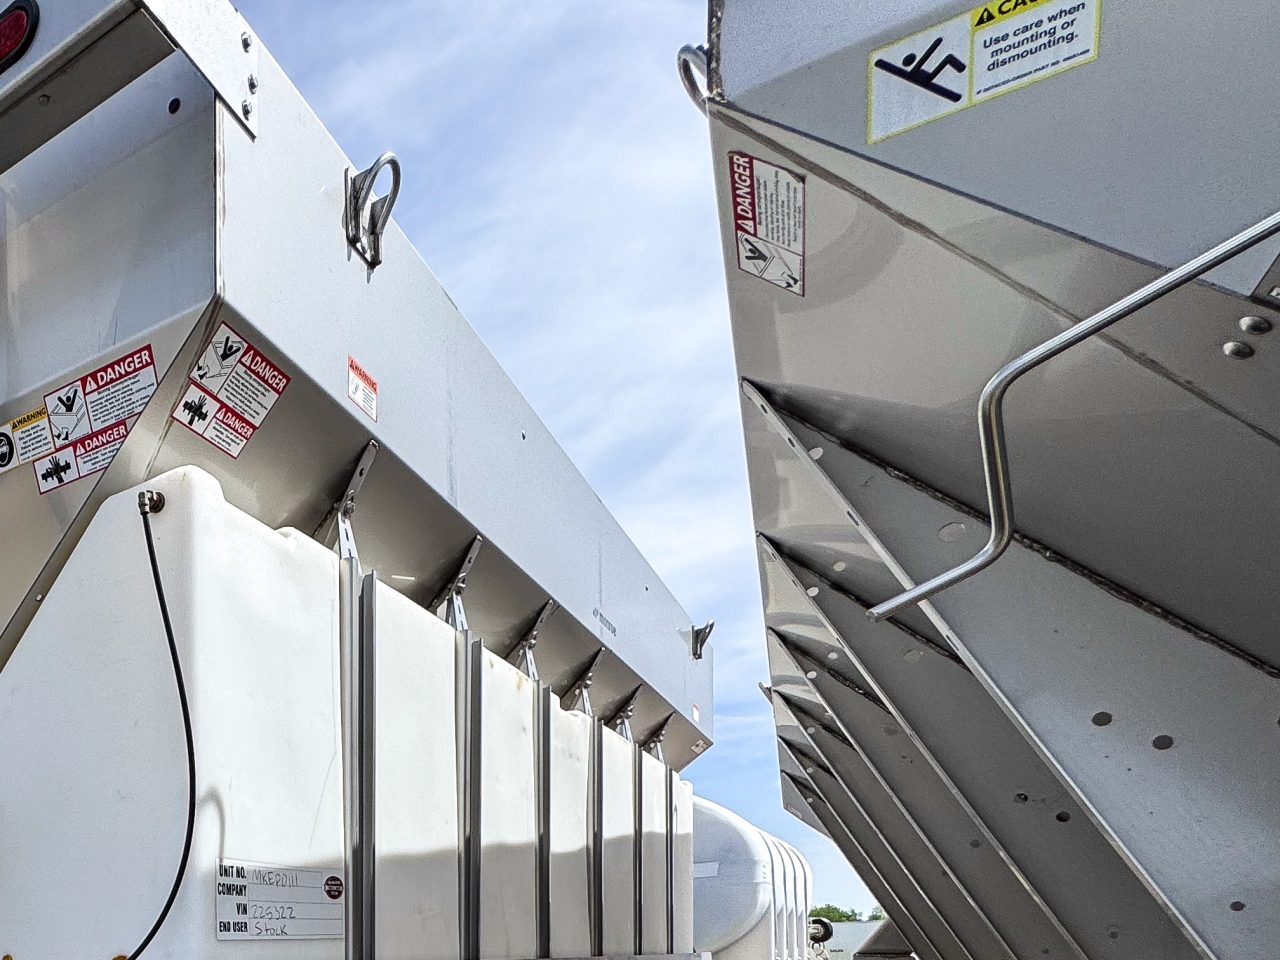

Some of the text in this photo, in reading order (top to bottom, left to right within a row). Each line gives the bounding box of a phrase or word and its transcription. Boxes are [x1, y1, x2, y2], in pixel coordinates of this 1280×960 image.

[983, 2, 1086, 49] Use care when
[990, 25, 1057, 59] mounting
[1061, 17, 1077, 31] or
[986, 31, 1079, 72] dismounting.
[733, 154, 754, 219] DANGER
[97, 350, 151, 385] DANGER
[250, 355, 286, 391] DANGER
[18, 408, 47, 426] WARNING
[223, 411, 254, 437] DANGER
[84, 425, 127, 451] DANGER
[219, 864, 247, 879] UNIT NO.
[217, 882, 247, 897] COMPANY
[235, 902, 248, 916] VIN
[219, 921, 248, 933] END USER
